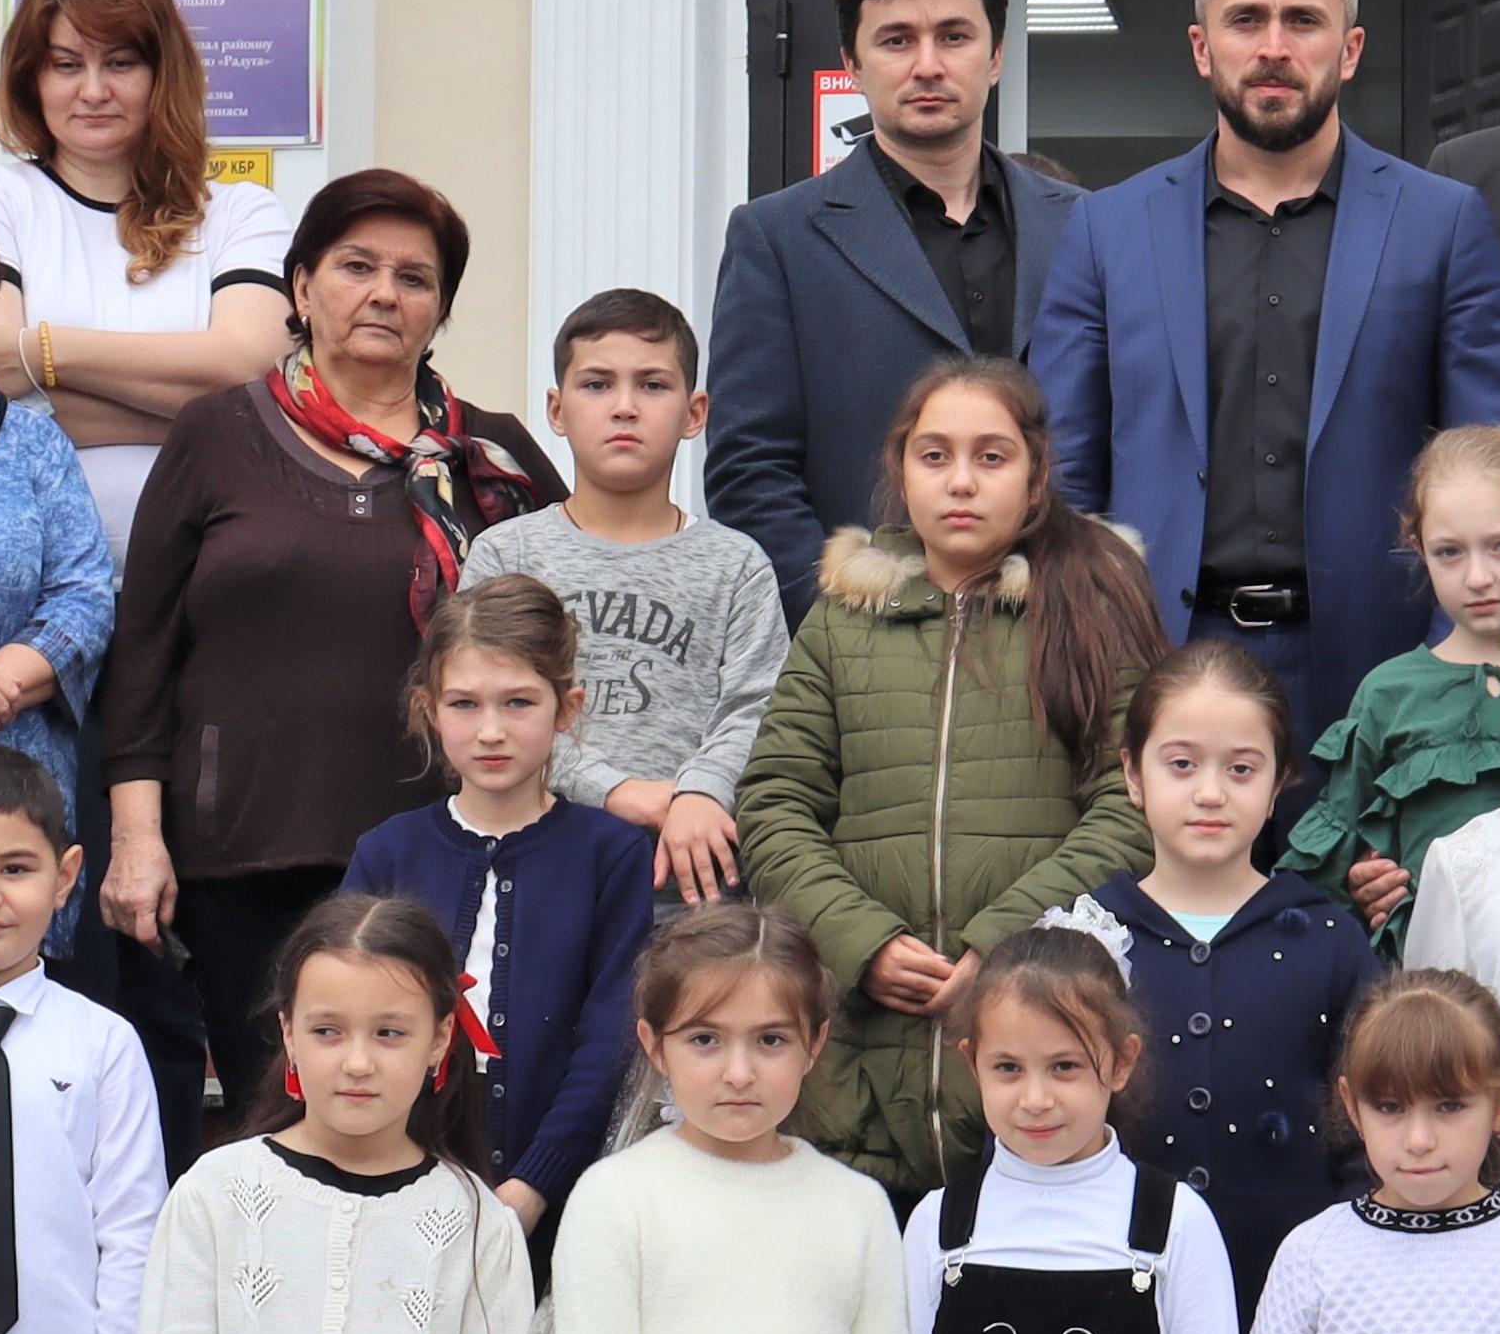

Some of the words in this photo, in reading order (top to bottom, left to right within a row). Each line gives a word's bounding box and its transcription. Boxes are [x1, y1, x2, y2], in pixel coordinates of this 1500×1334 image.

[206, 91, 234, 100] азна
[231, 160, 255, 174] КБР
[563, 591, 695, 666] VADA
[579, 658, 654, 716] UES
